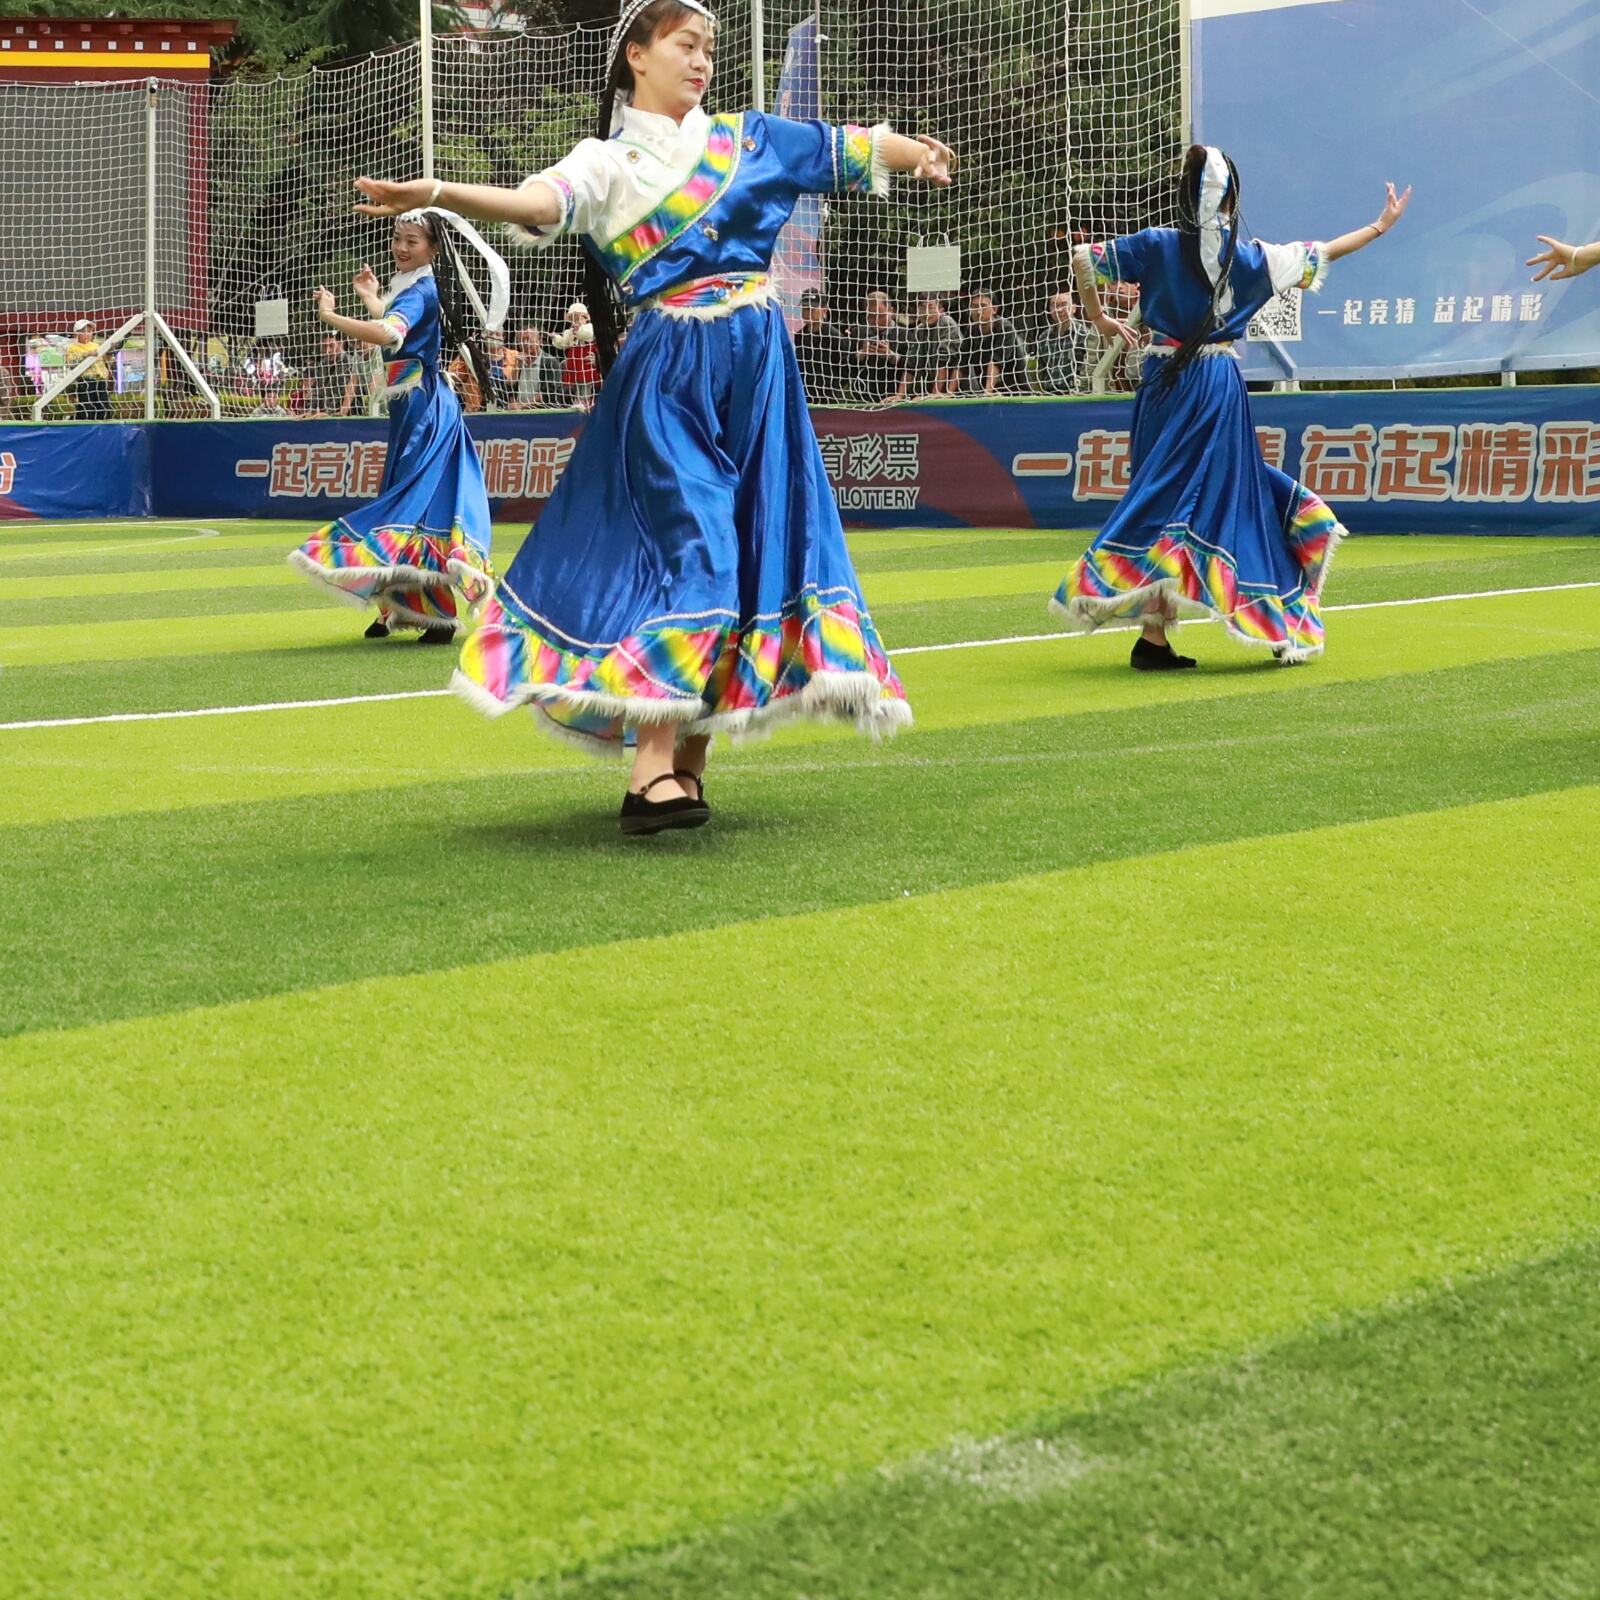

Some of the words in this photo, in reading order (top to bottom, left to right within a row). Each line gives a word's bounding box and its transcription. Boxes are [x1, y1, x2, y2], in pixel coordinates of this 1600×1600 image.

[1318, 298, 1415, 325] 一起竞猜
[1433, 293, 1544, 324] 益起精彩
[236, 441, 388, 497] 一起竞猜
[474, 437, 576, 498] 精彩
[816, 433, 919, 481] 育彩票
[839, 487, 920, 509] LOTTERY
